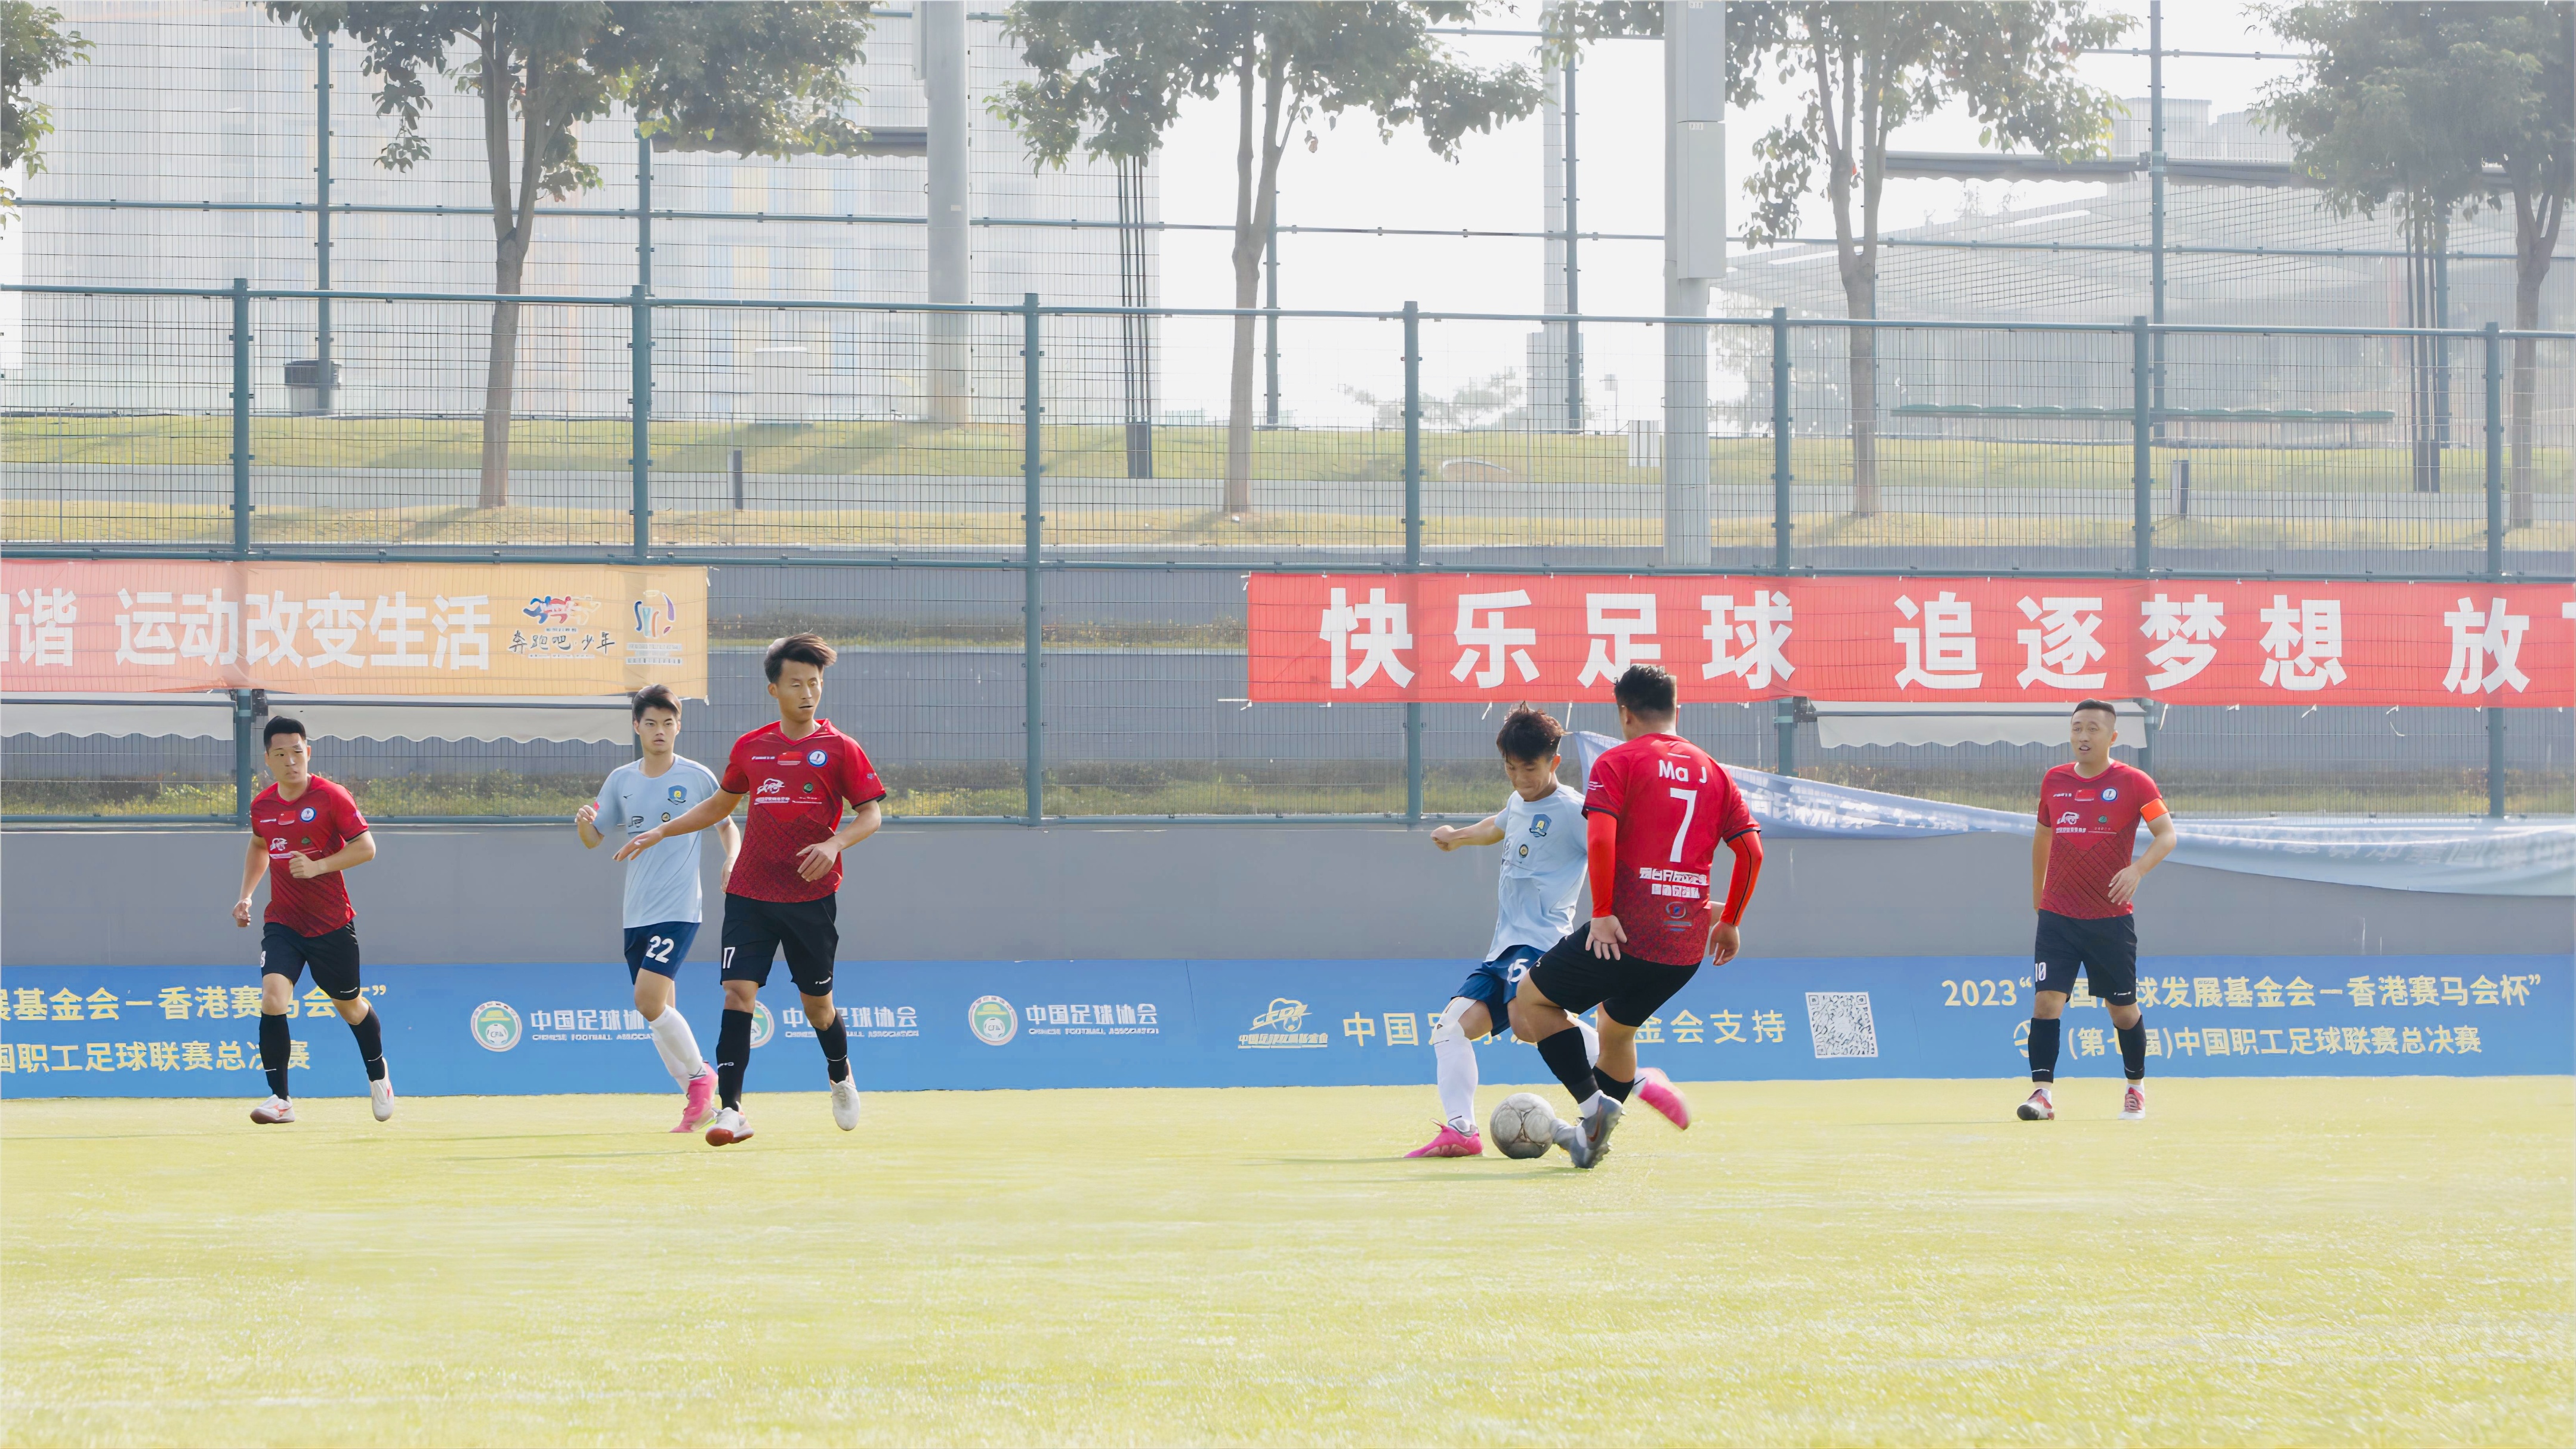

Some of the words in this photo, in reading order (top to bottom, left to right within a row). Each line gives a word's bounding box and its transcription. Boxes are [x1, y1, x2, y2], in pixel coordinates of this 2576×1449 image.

[115, 588, 490, 670] 运动改变生活
[1319, 588, 1796, 689] 快乐足球
[1894, 591, 2347, 691] 追逐梦想
[2442, 597, 2575, 694] 放
[1658, 760, 1689, 782] Ma
[1670, 788, 1697, 863] 7
[646, 935, 674, 963] 22
[723, 947, 735, 969] 17
[2035, 961, 2047, 982] 10
[530, 1009, 652, 1031] 中国足球协
[1026, 1003, 1158, 1025] 中国足球协会
